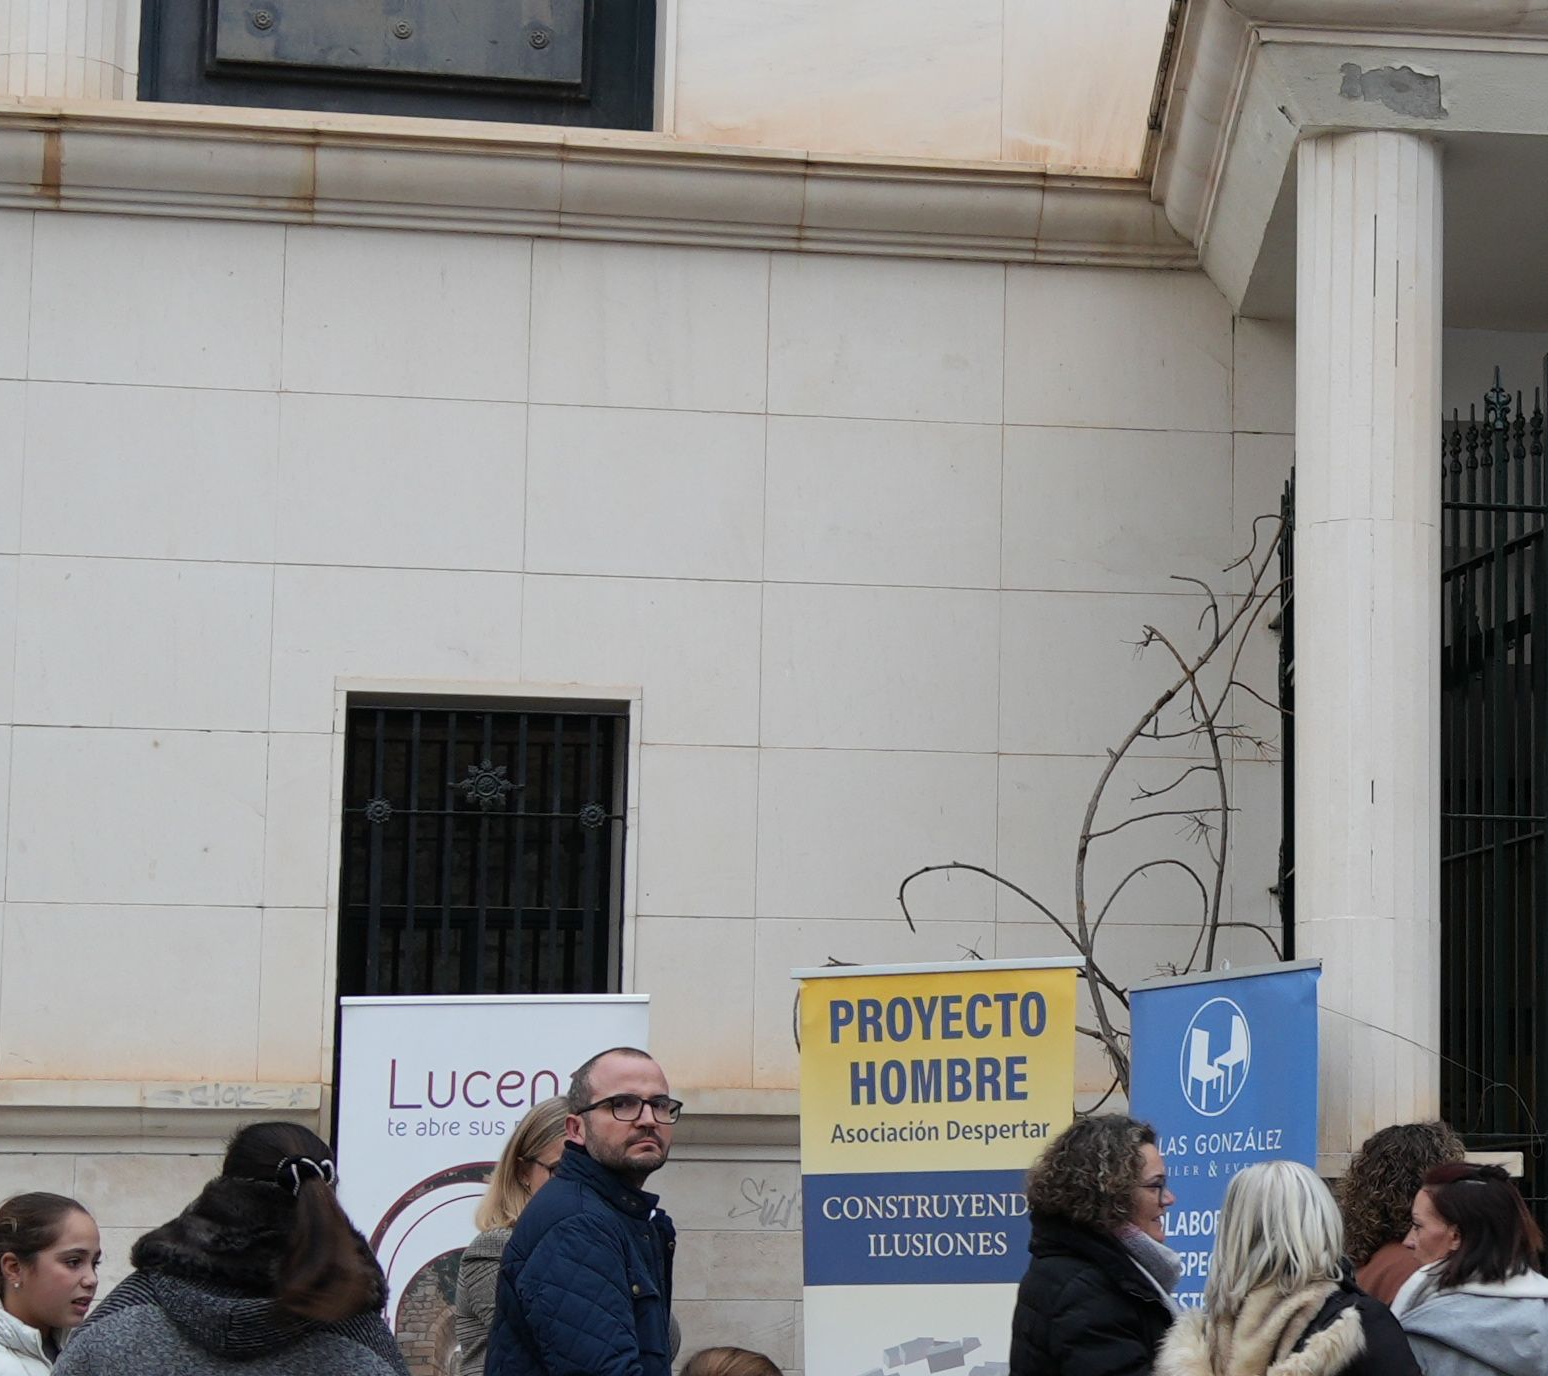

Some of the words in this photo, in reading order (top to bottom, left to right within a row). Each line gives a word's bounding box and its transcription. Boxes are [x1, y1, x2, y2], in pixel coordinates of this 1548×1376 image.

[829, 991, 1047, 1044] PROYECTO
[388, 1058, 560, 1110] Lucen
[849, 1056, 1029, 1106] HOMBRE
[387, 1118, 407, 1137] te
[415, 1117, 461, 1137] abre
[469, 1120, 506, 1136] sus
[830, 1119, 940, 1144] Asociación
[946, 1119, 1051, 1145] Despertar
[1157, 1135, 1188, 1156] LAS
[1194, 1126, 1283, 1155] GONZÁLEZ
[1167, 1164, 1200, 1177] ILER
[1208, 1159, 1218, 1178] &
[822, 1193, 1029, 1221] CONSTRUYEND
[867, 1231, 1008, 1258] ILUSIONES
